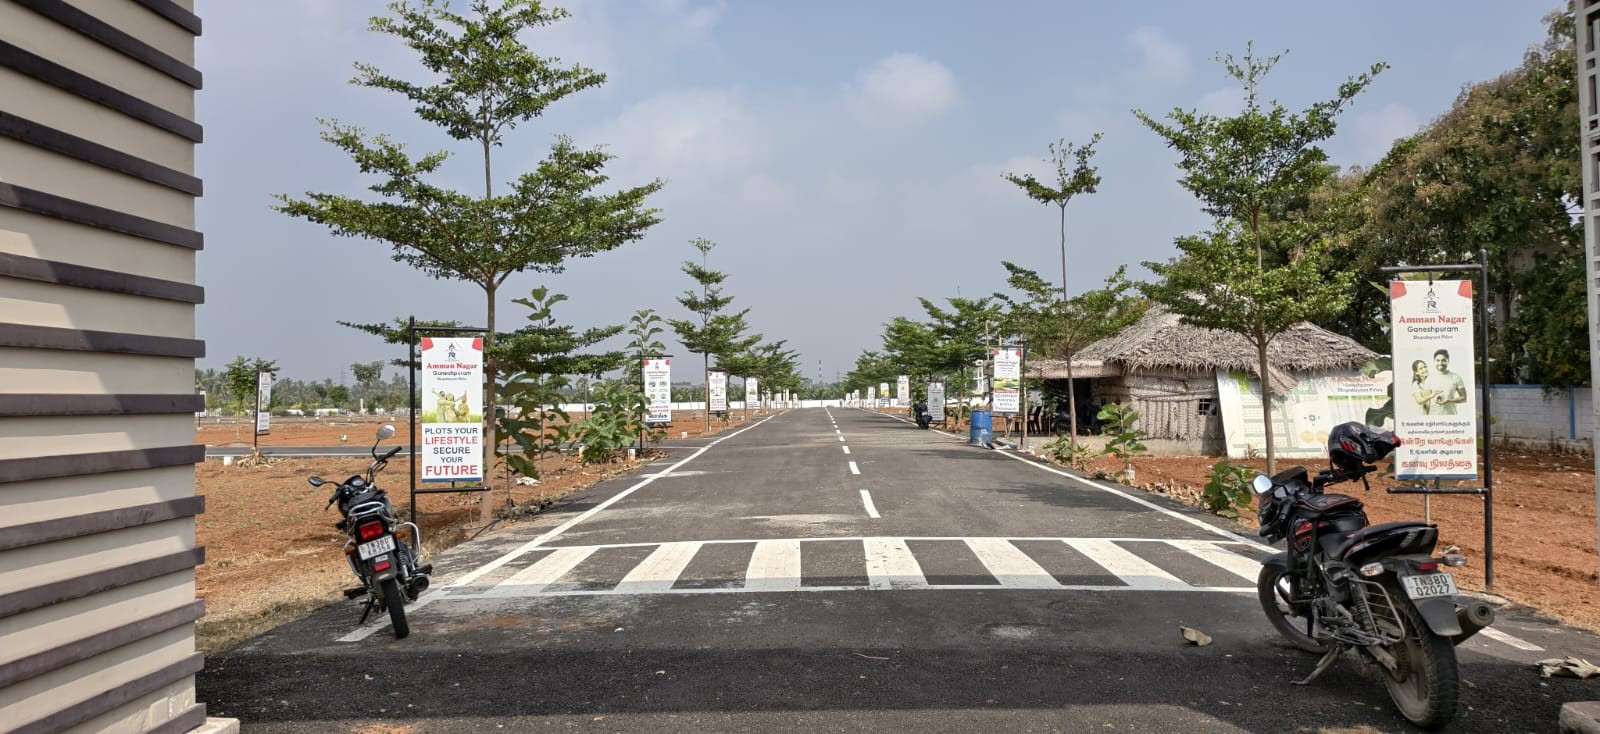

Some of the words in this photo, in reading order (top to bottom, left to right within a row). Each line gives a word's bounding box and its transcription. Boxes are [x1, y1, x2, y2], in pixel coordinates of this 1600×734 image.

[1399, 316, 1436, 324] Amman
[1438, 316, 1467, 325] Nagar
[1407, 326, 1459, 334] Ganeshpuram
[425, 427, 453, 435] PLOTS
[425, 436, 478, 445] LIFESTYLE
[433, 446, 471, 454] SECURE
[1401, 460, 1428, 469] கனவு
[1429, 459, 1473, 470] நிலத்தை
[425, 465, 478, 476] FUTURE
